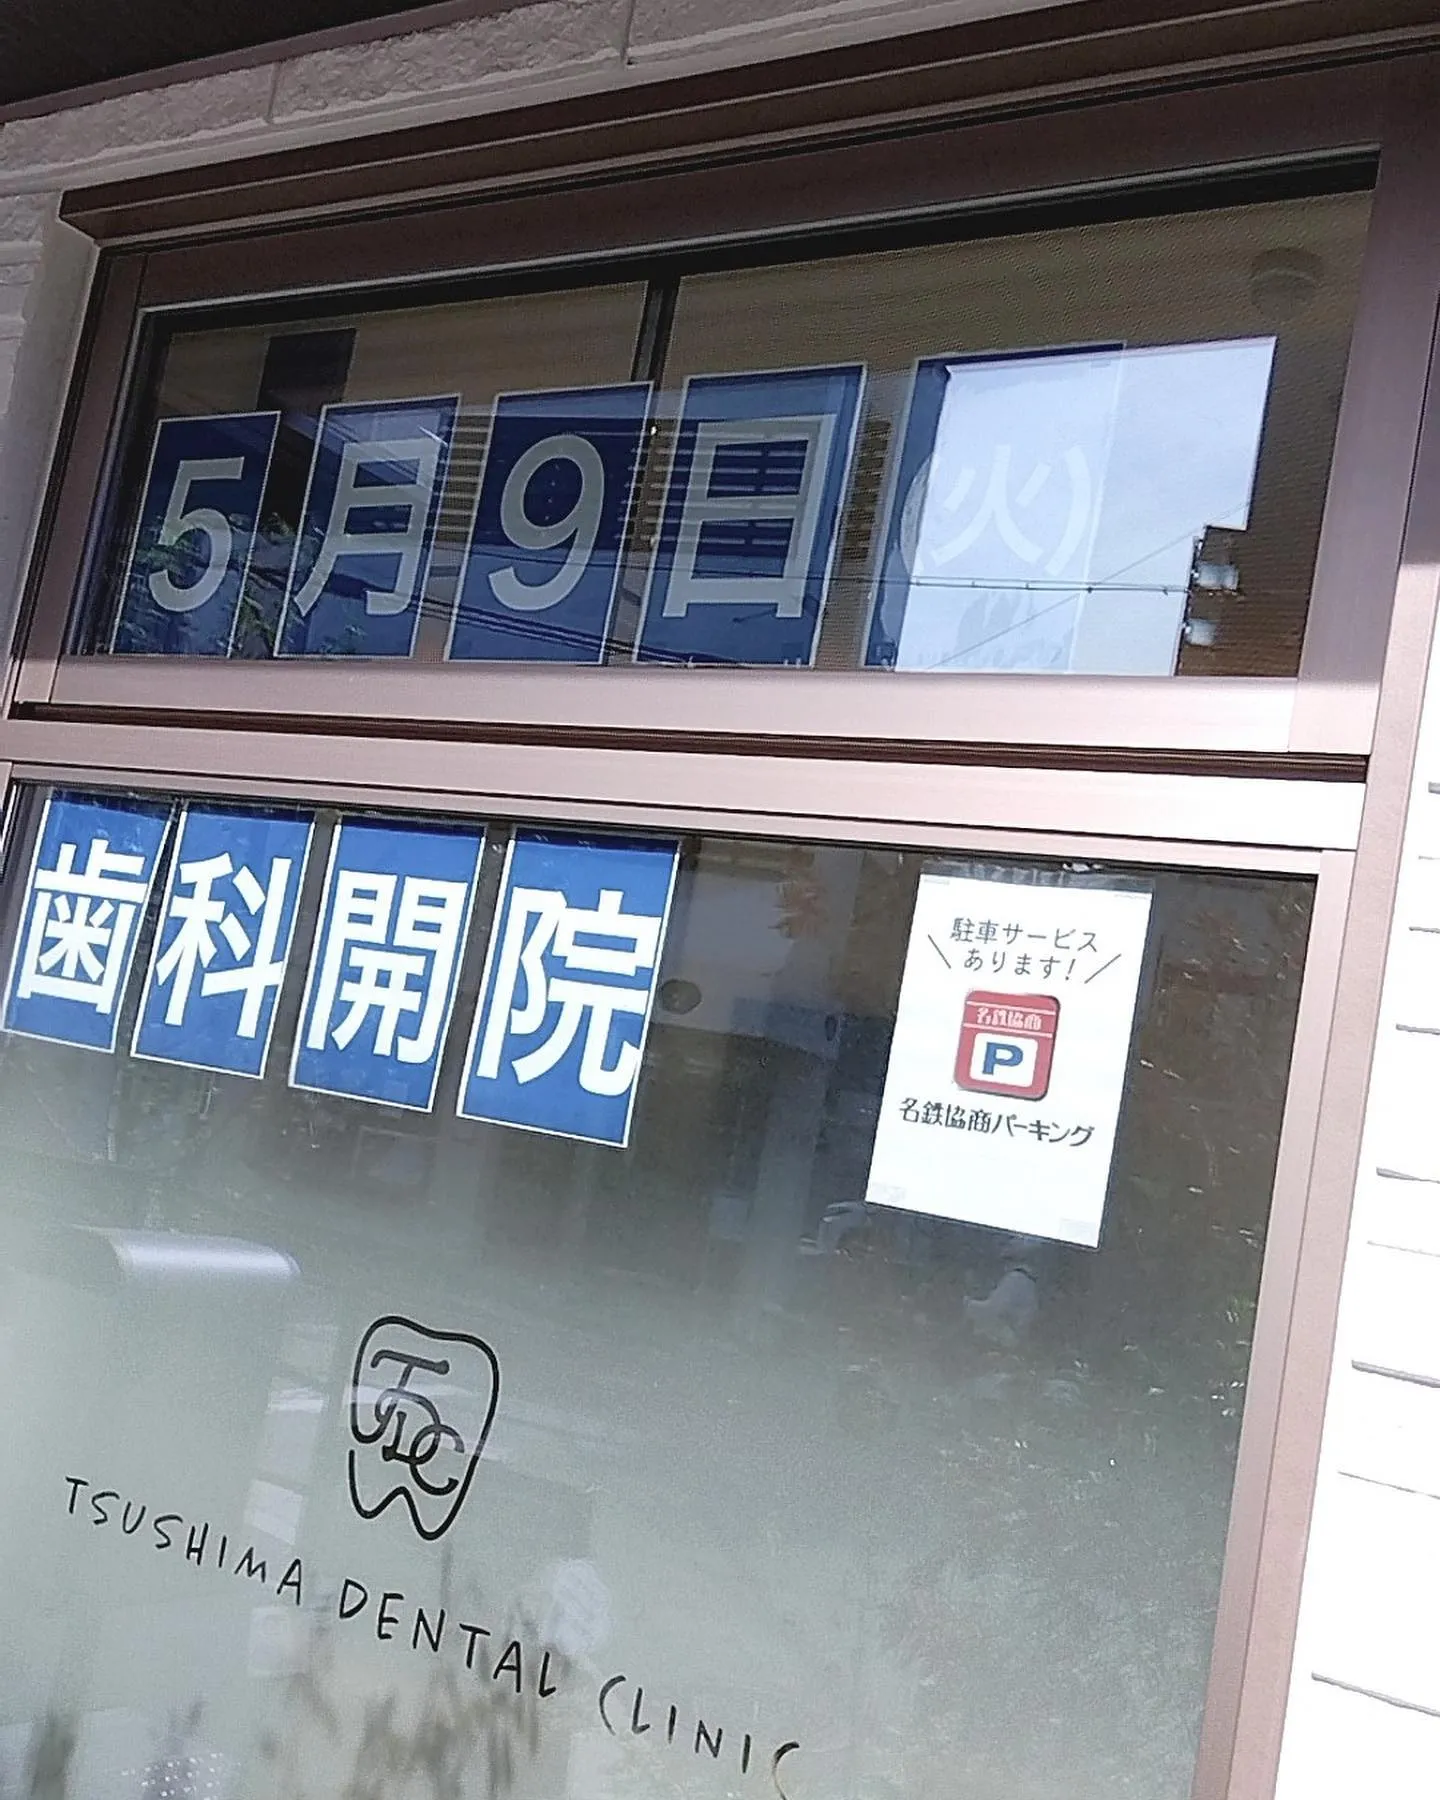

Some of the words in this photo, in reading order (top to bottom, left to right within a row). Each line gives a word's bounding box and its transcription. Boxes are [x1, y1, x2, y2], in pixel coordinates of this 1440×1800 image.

[948, 916, 1099, 954] 駐車サービス
[15, 838, 663, 1097] 歯科開院
[982, 1041, 1024, 1075] P
[899, 1096, 1096, 1148] 名鉄協商パーキング
[64, 1475, 303, 1606] TSUSHIMA
[338, 1577, 557, 1698] DENTAL
[599, 1674, 801, 1800] CLINIC
